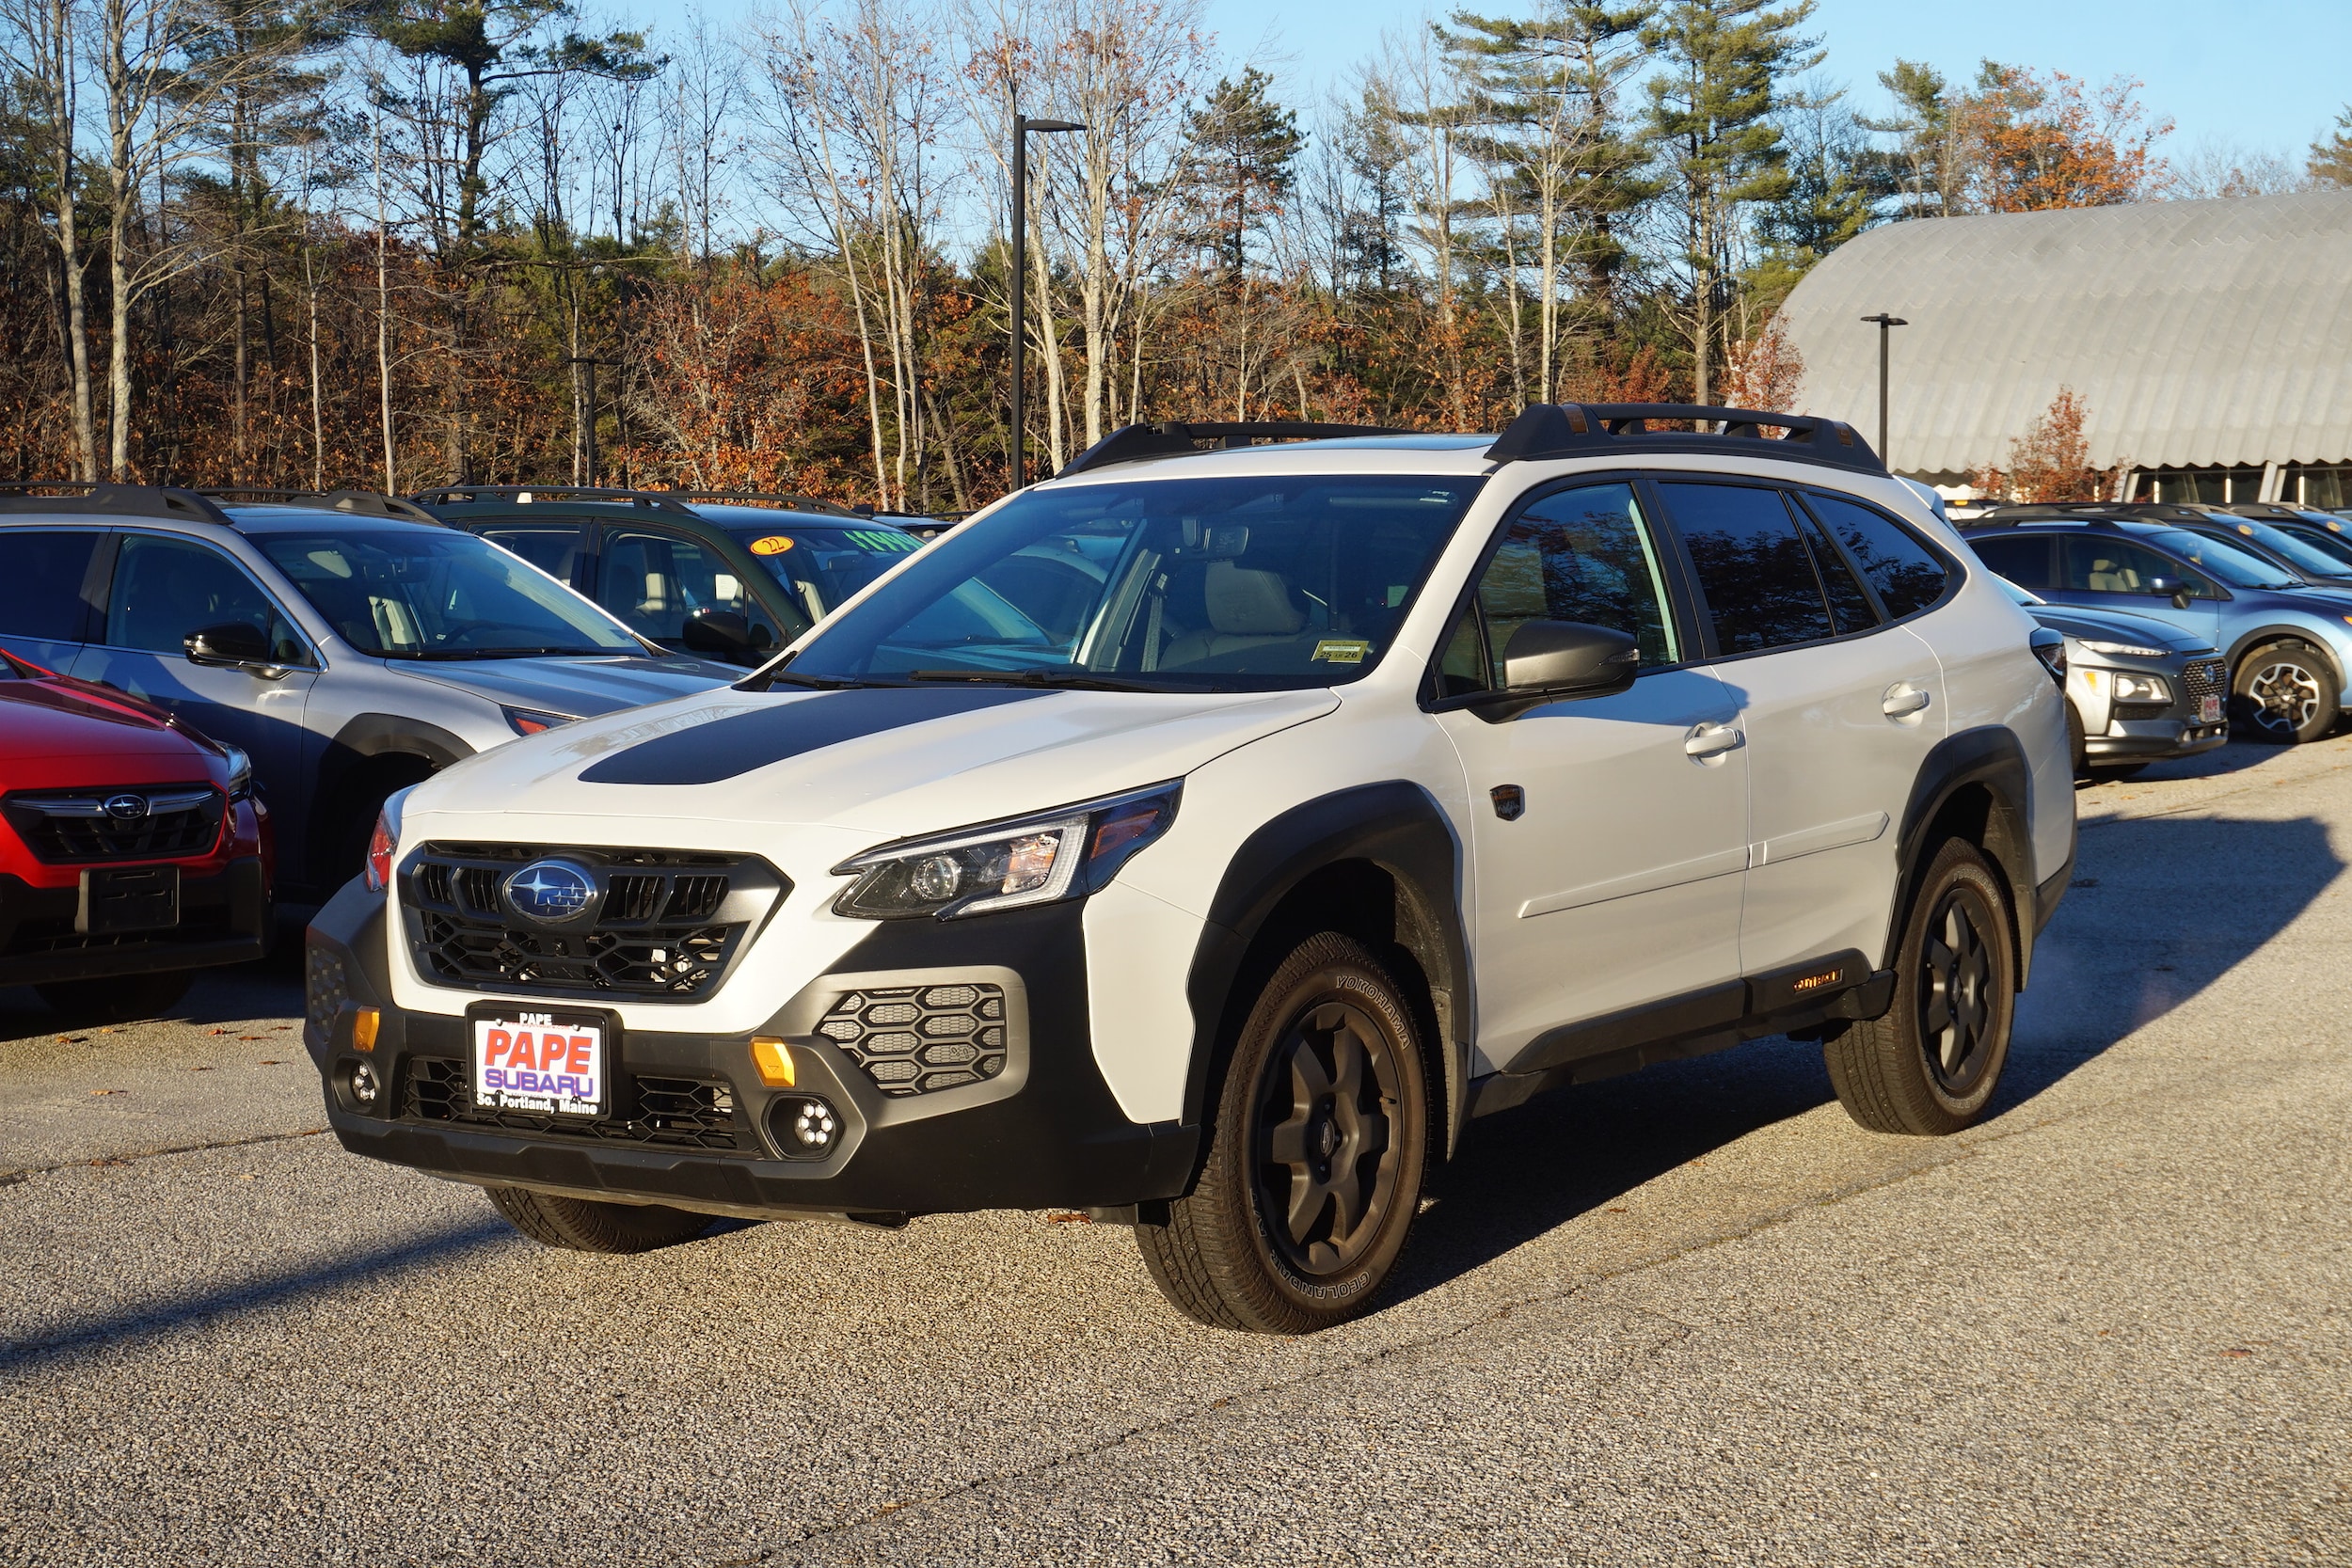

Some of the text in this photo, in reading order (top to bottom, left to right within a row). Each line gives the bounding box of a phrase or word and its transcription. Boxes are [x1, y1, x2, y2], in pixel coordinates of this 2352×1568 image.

[762, 538, 785, 553] 22
[518, 1012, 553, 1026] PAPE
[1336, 974, 1412, 1052] YOKOHAMA
[485, 1029, 593, 1075] PAPE
[485, 1069, 594, 1098] SUBARU
[476, 1092, 496, 1107] So.
[500, 1094, 555, 1115] Portland,
[559, 1100, 597, 1116] Maine
[1269, 1248, 1372, 1300] GEOLANDAR
